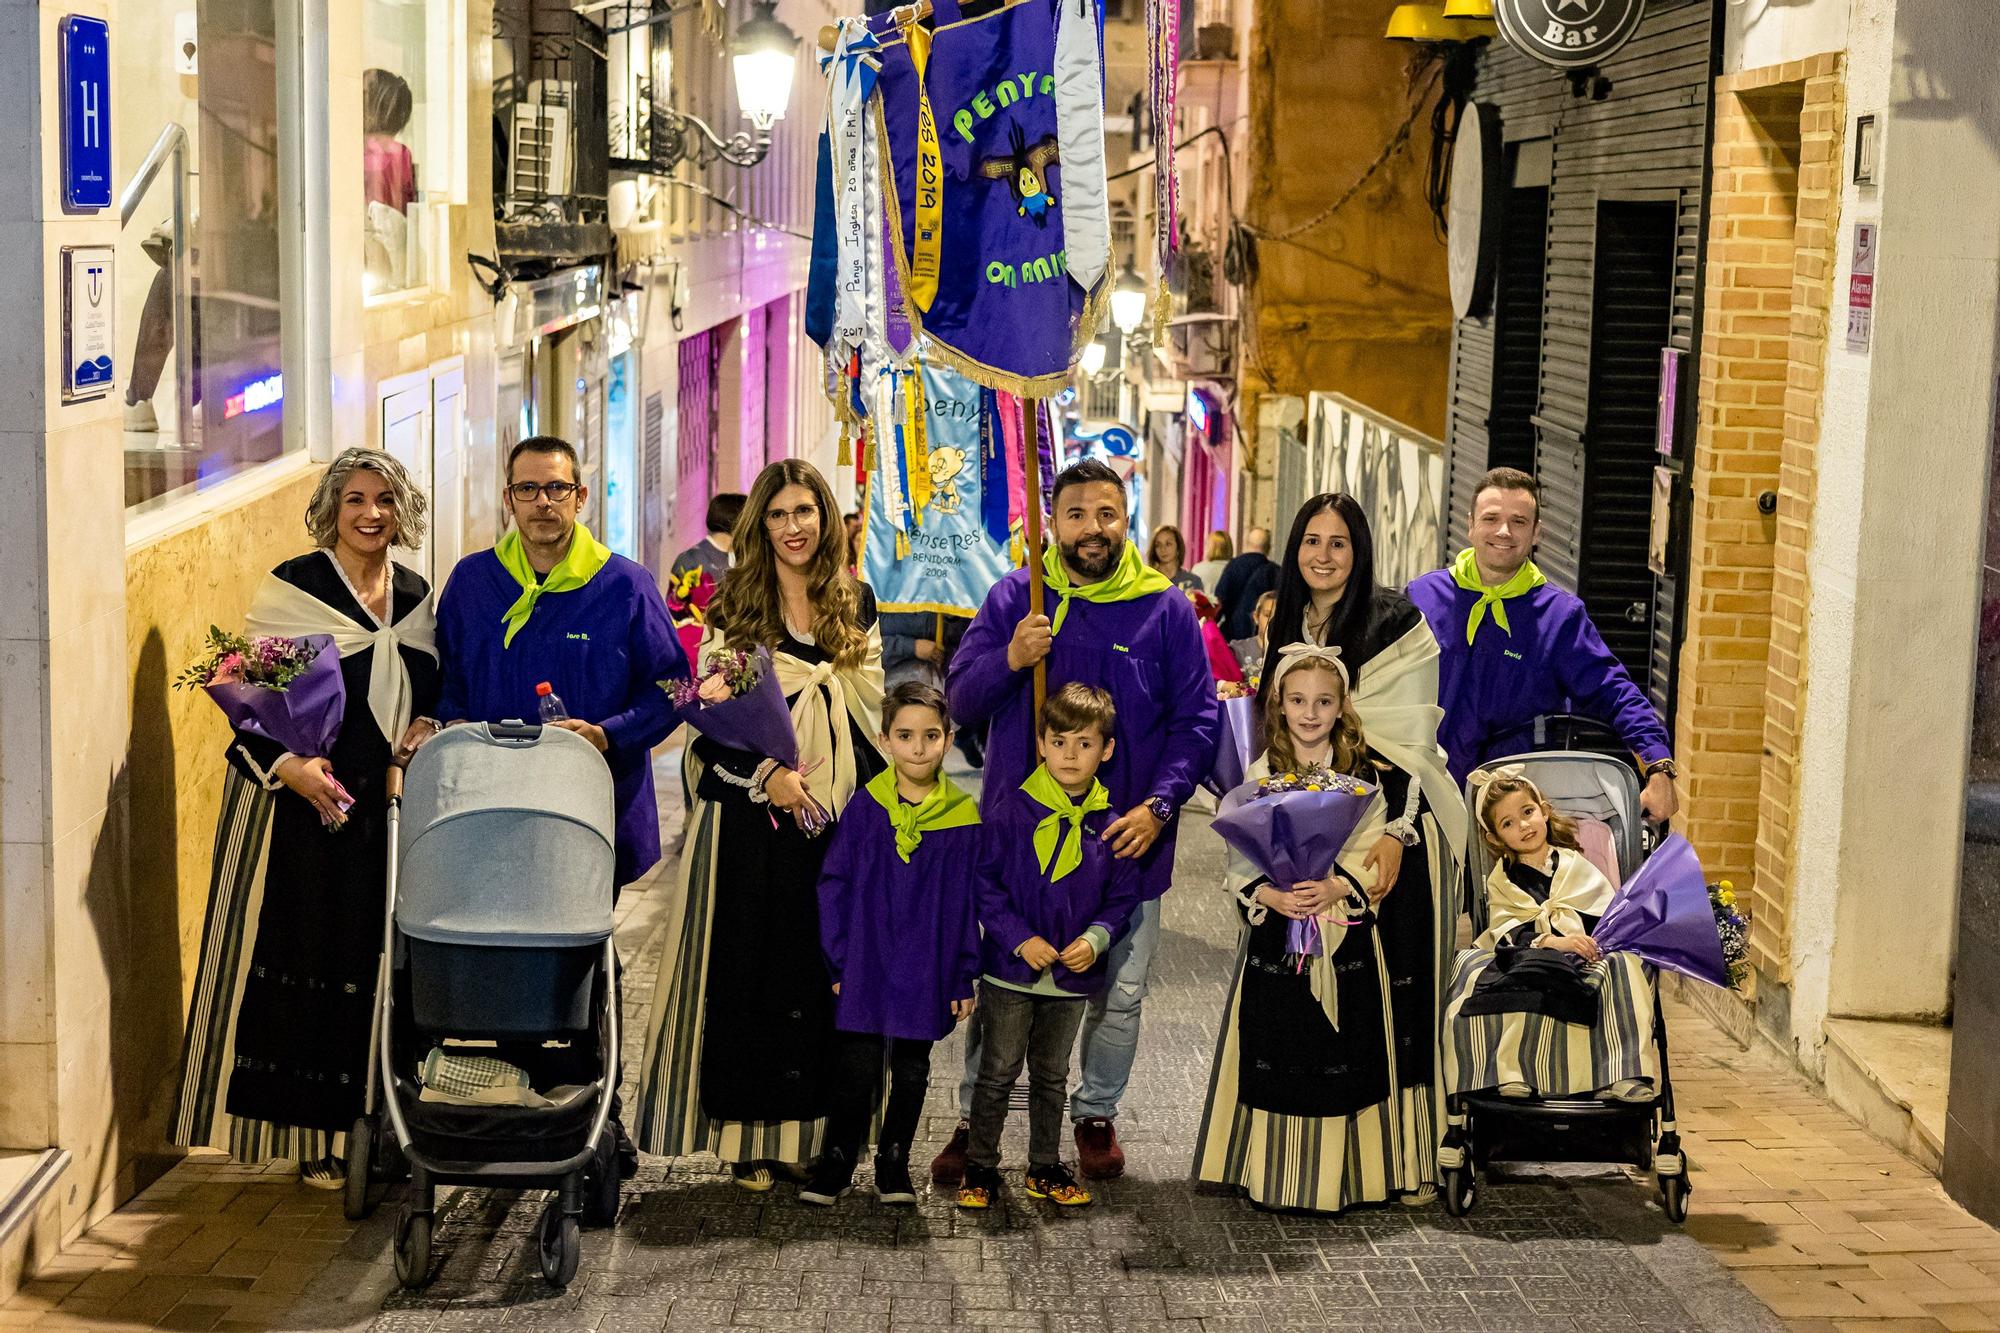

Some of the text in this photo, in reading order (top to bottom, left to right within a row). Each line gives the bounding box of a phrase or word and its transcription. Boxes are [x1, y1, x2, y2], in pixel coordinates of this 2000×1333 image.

[1543, 20, 1598, 47] Bar
[80, 80, 99, 148] H
[848, 147, 857, 172] años
[985, 162, 1014, 174] FESTES
[848, 177, 857, 193] 20
[919, 152, 937, 209] 2019
[845, 204, 861, 248] Inglesa
[845, 258, 863, 293] Penya
[1850, 279, 1871, 295] Alarma
[843, 326, 863, 338] 2017
[913, 552, 961, 567] BENIDORM
[925, 568, 948, 577] 2008
